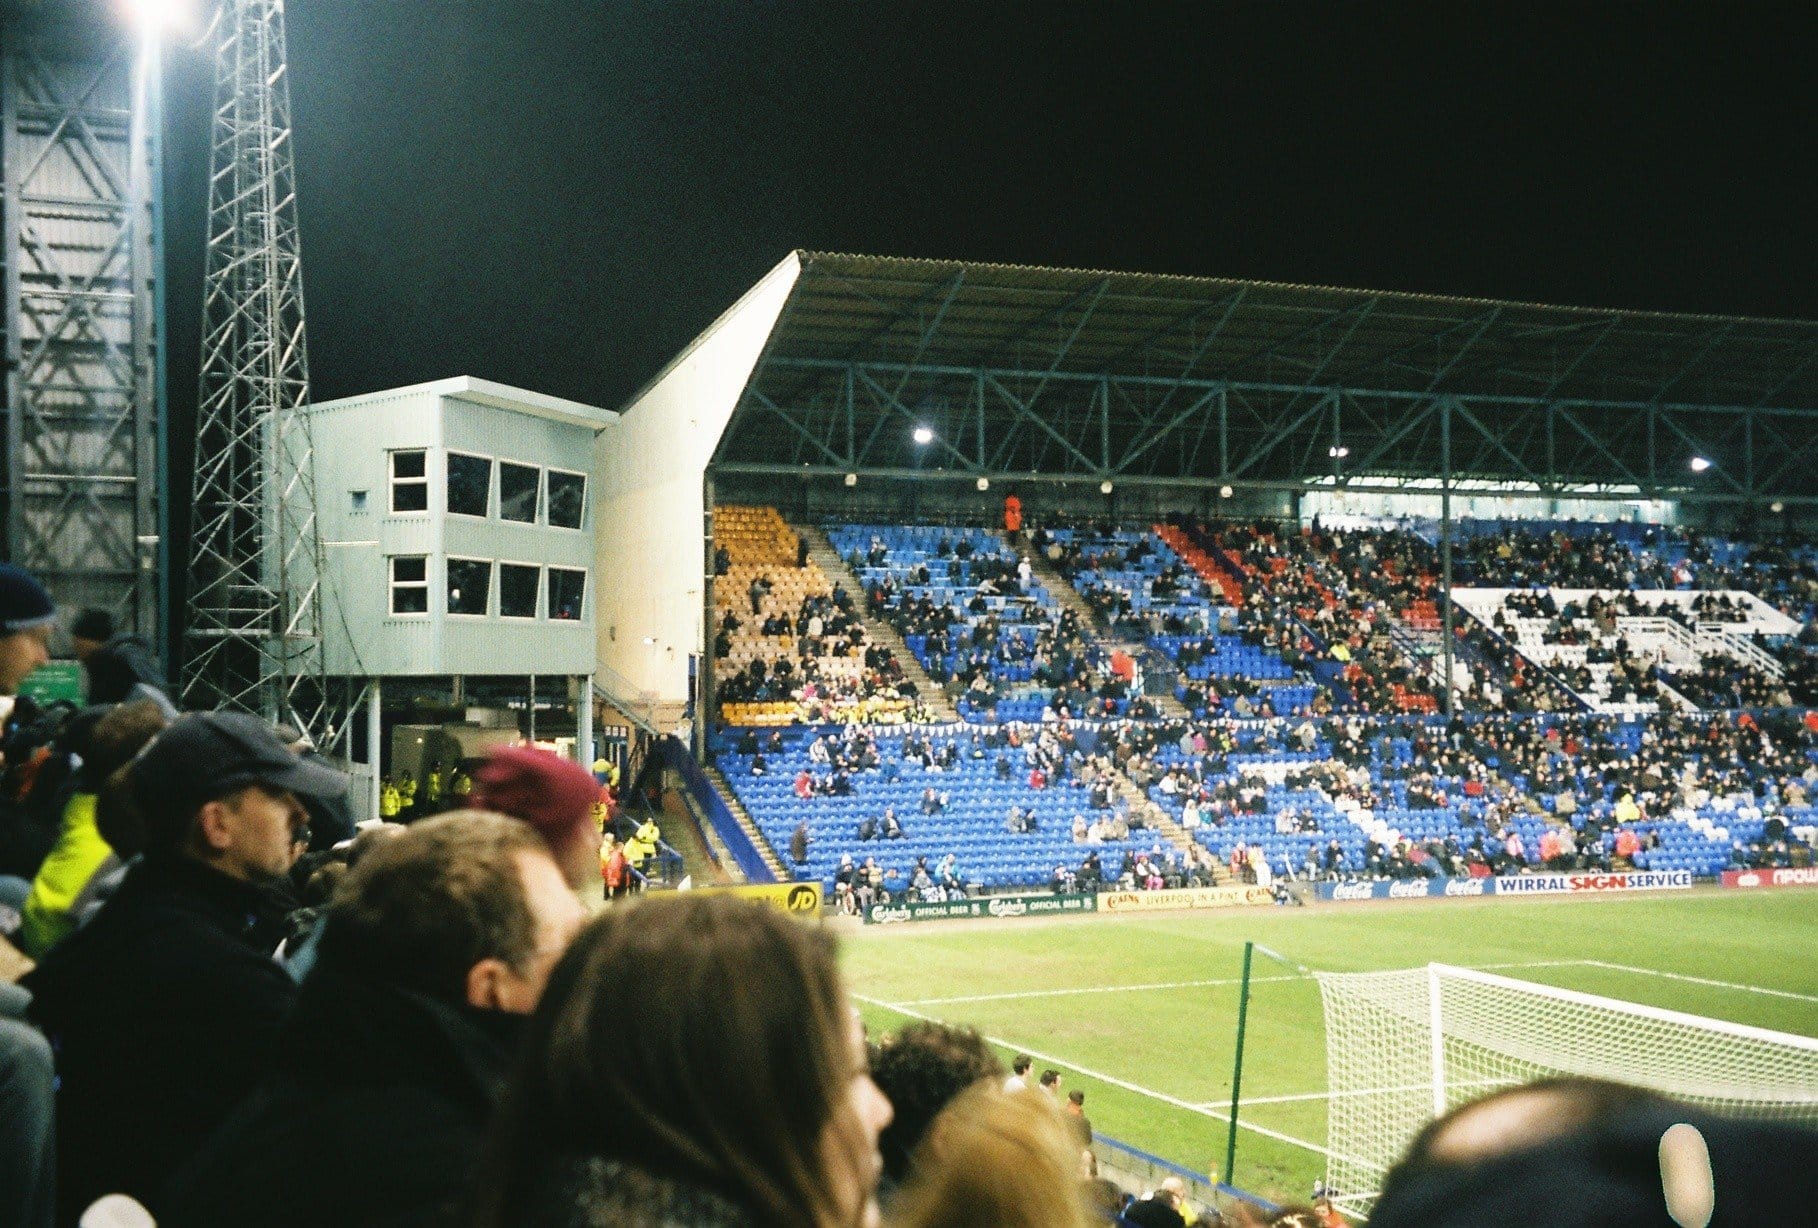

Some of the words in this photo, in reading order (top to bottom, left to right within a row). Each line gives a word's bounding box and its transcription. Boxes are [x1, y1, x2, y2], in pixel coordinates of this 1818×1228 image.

[1500, 877, 1567, 891] WIRRAL
[1569, 875, 1628, 891] SIGN
[1628, 873, 1690, 888] SERVICE
[915, 906, 948, 917] OFFICIAL
[949, 905, 968, 915] BEER
[1029, 900, 1062, 911] OFFICIAL
[1062, 899, 1081, 909] BEER
